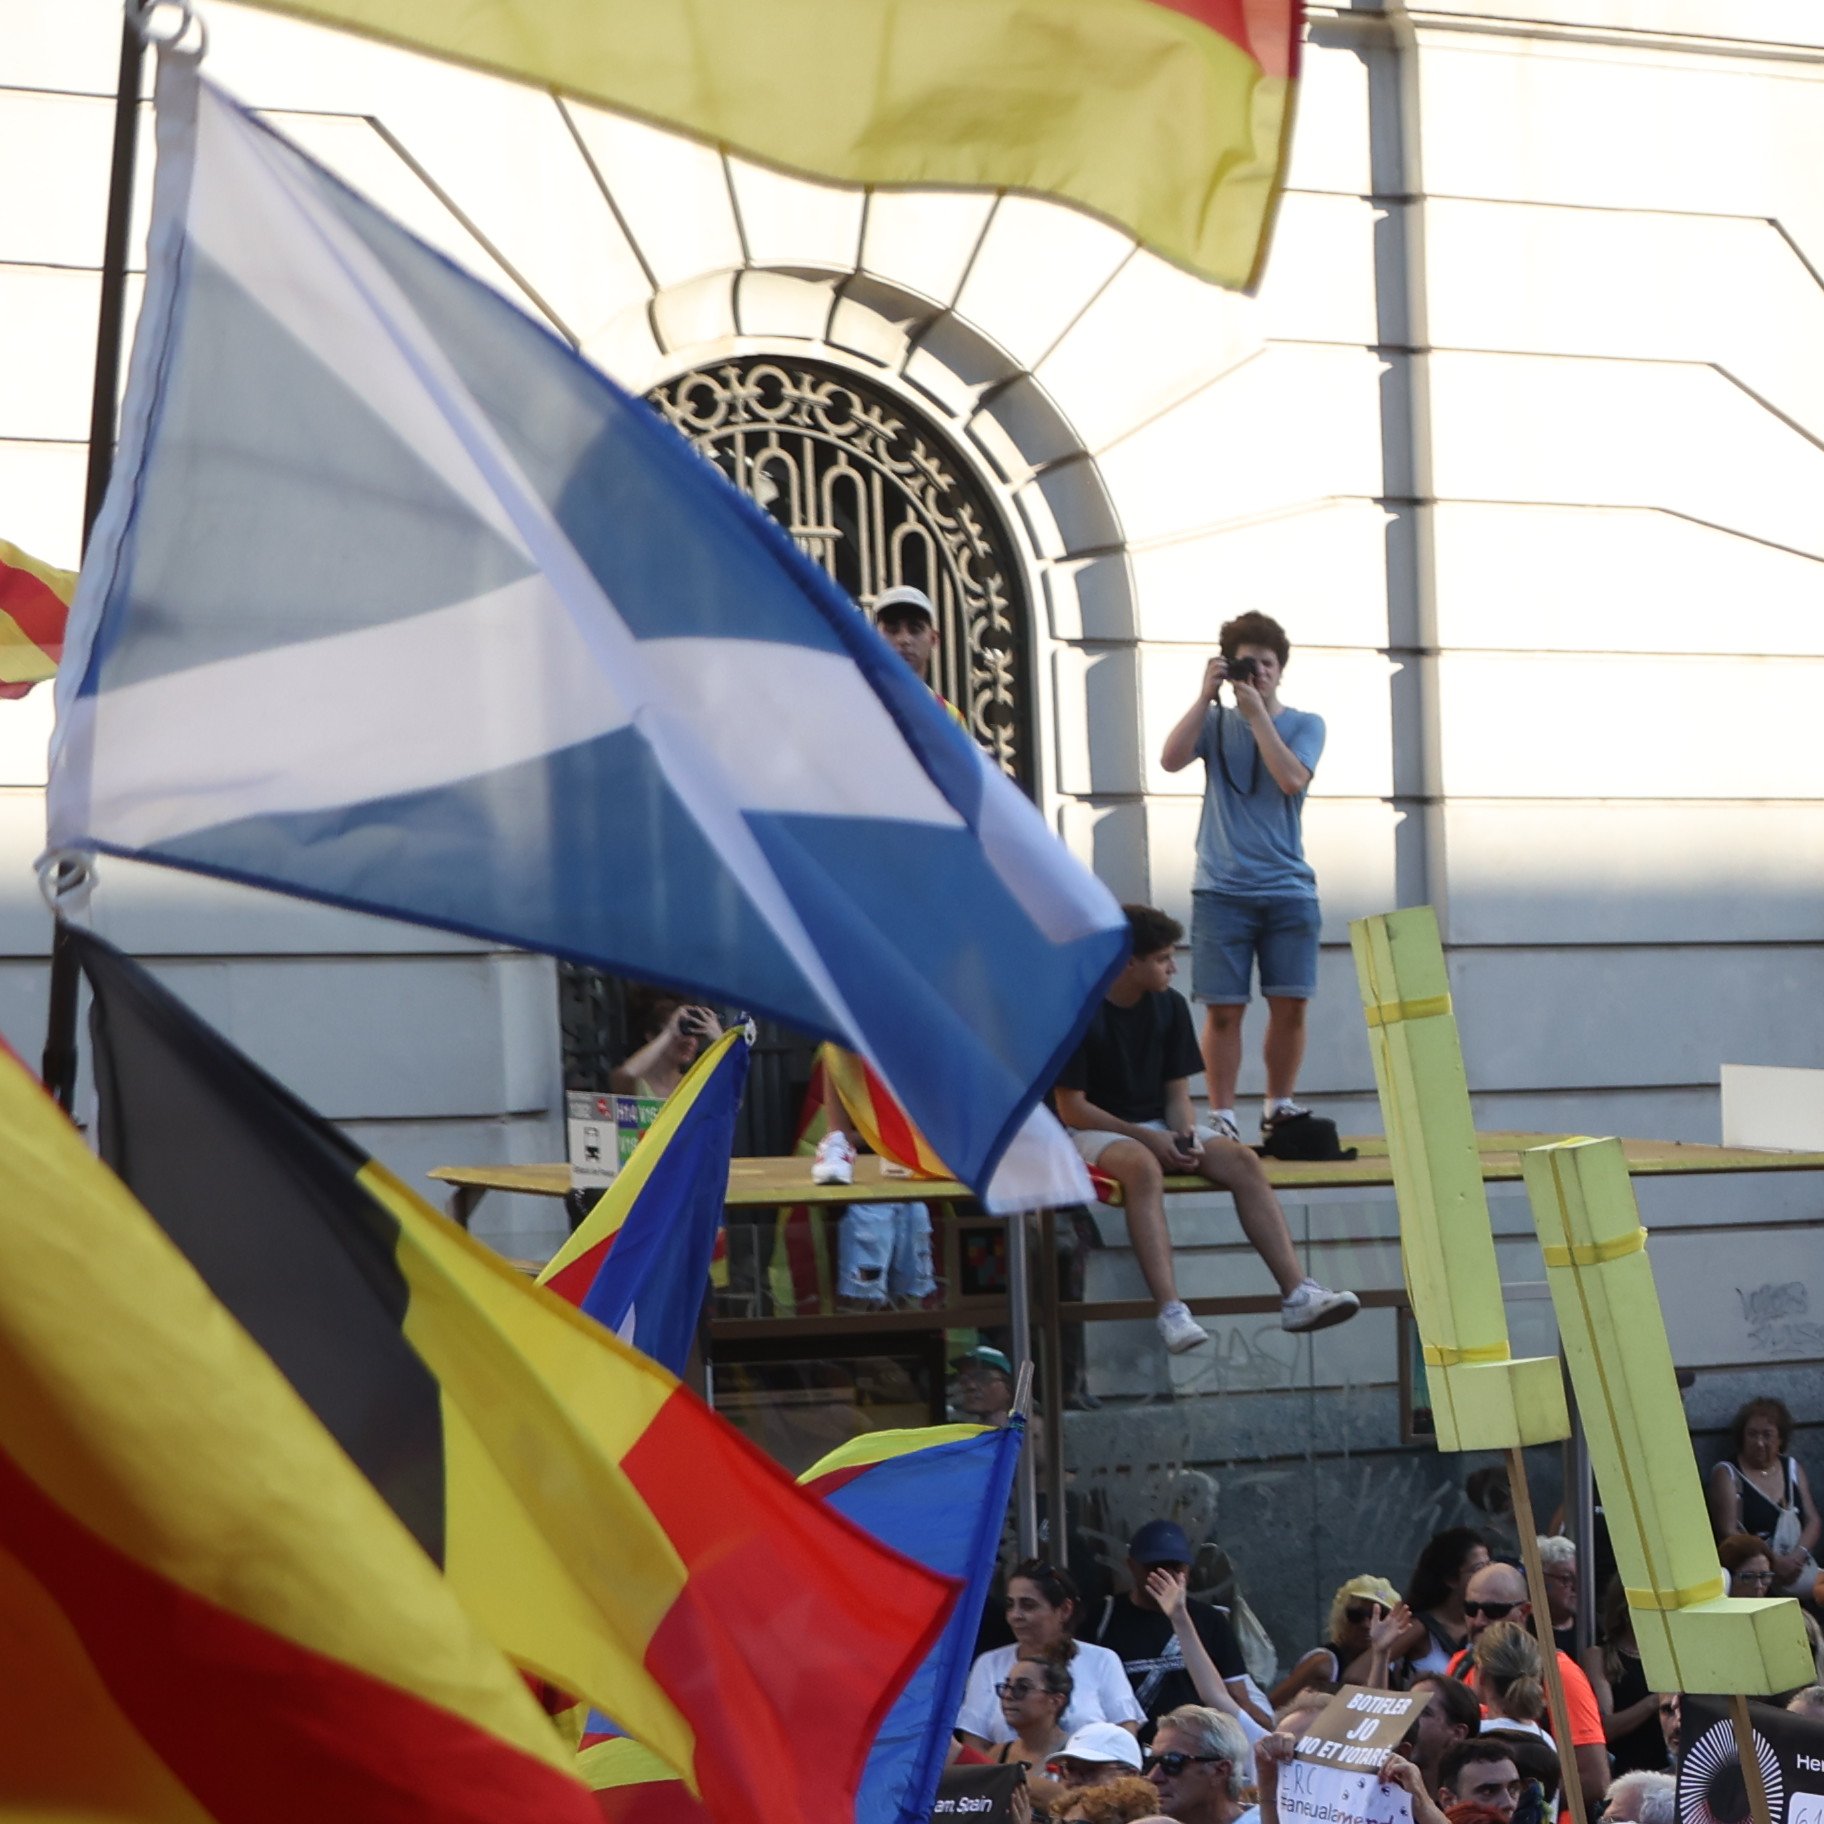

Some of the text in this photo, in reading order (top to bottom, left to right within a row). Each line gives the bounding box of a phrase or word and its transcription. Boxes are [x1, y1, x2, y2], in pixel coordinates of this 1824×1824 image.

[1346, 1692, 1413, 1715] BOTIFLER
[1346, 1717, 1380, 1742] JO
[1295, 1736, 1321, 1755] NO
[1317, 1740, 1342, 1758] ET
[956, 1796, 992, 1814] Spain
